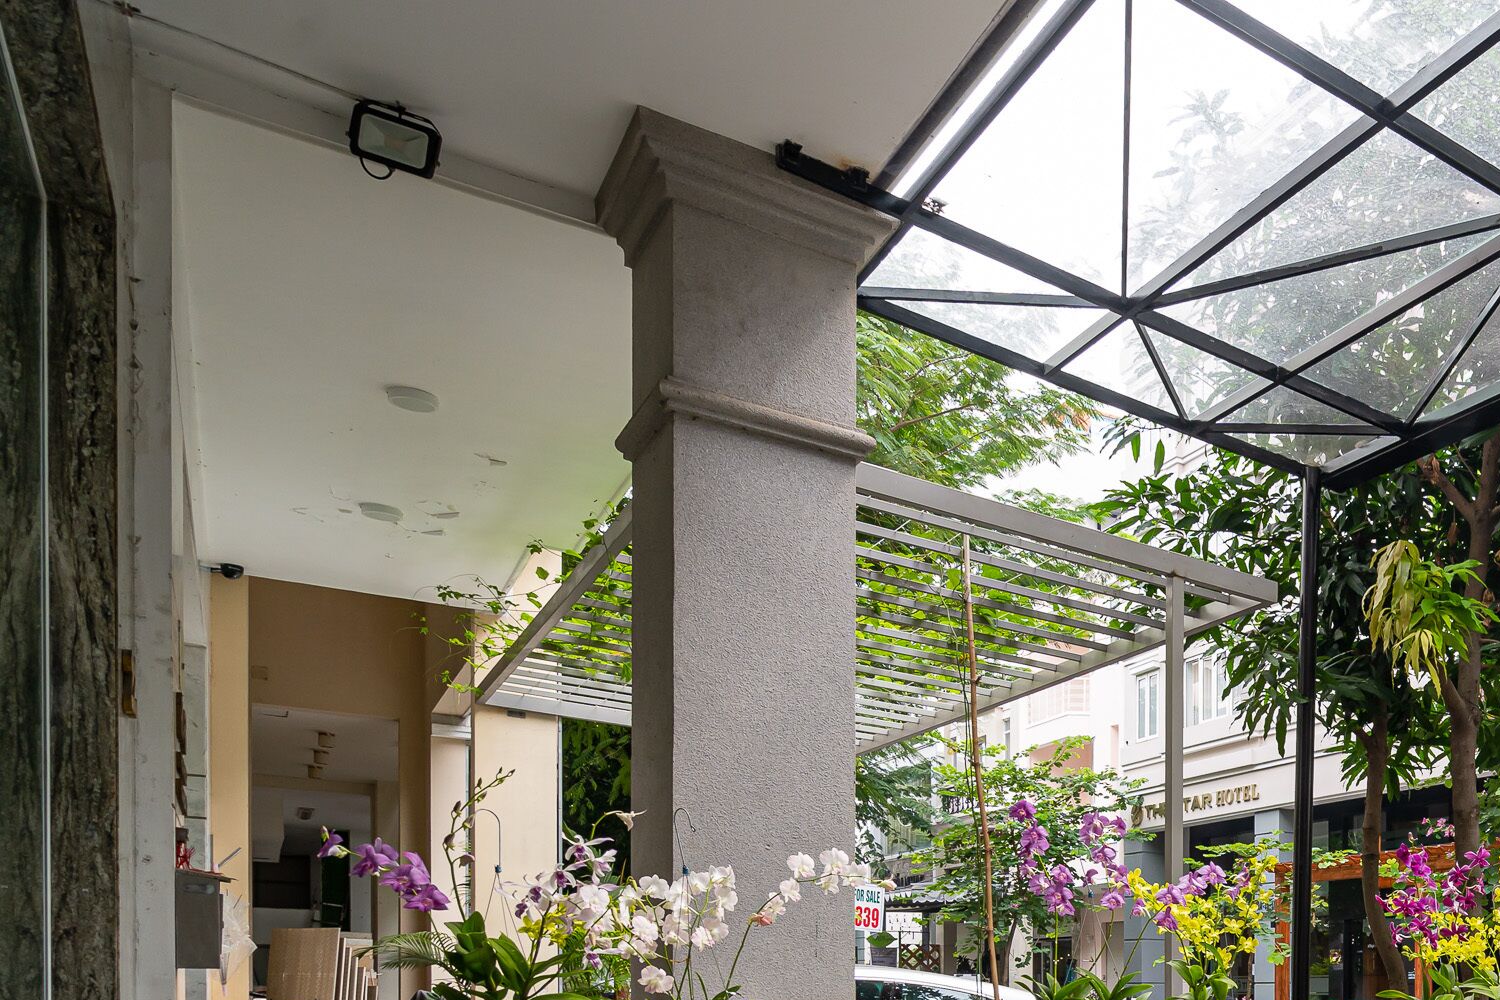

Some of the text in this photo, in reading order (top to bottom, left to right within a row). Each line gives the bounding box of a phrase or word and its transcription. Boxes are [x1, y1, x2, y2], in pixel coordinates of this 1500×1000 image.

[1183, 793, 1213, 813] TAR
[1215, 784, 1260, 808] HOTEL
[866, 890, 880, 903] SALE
